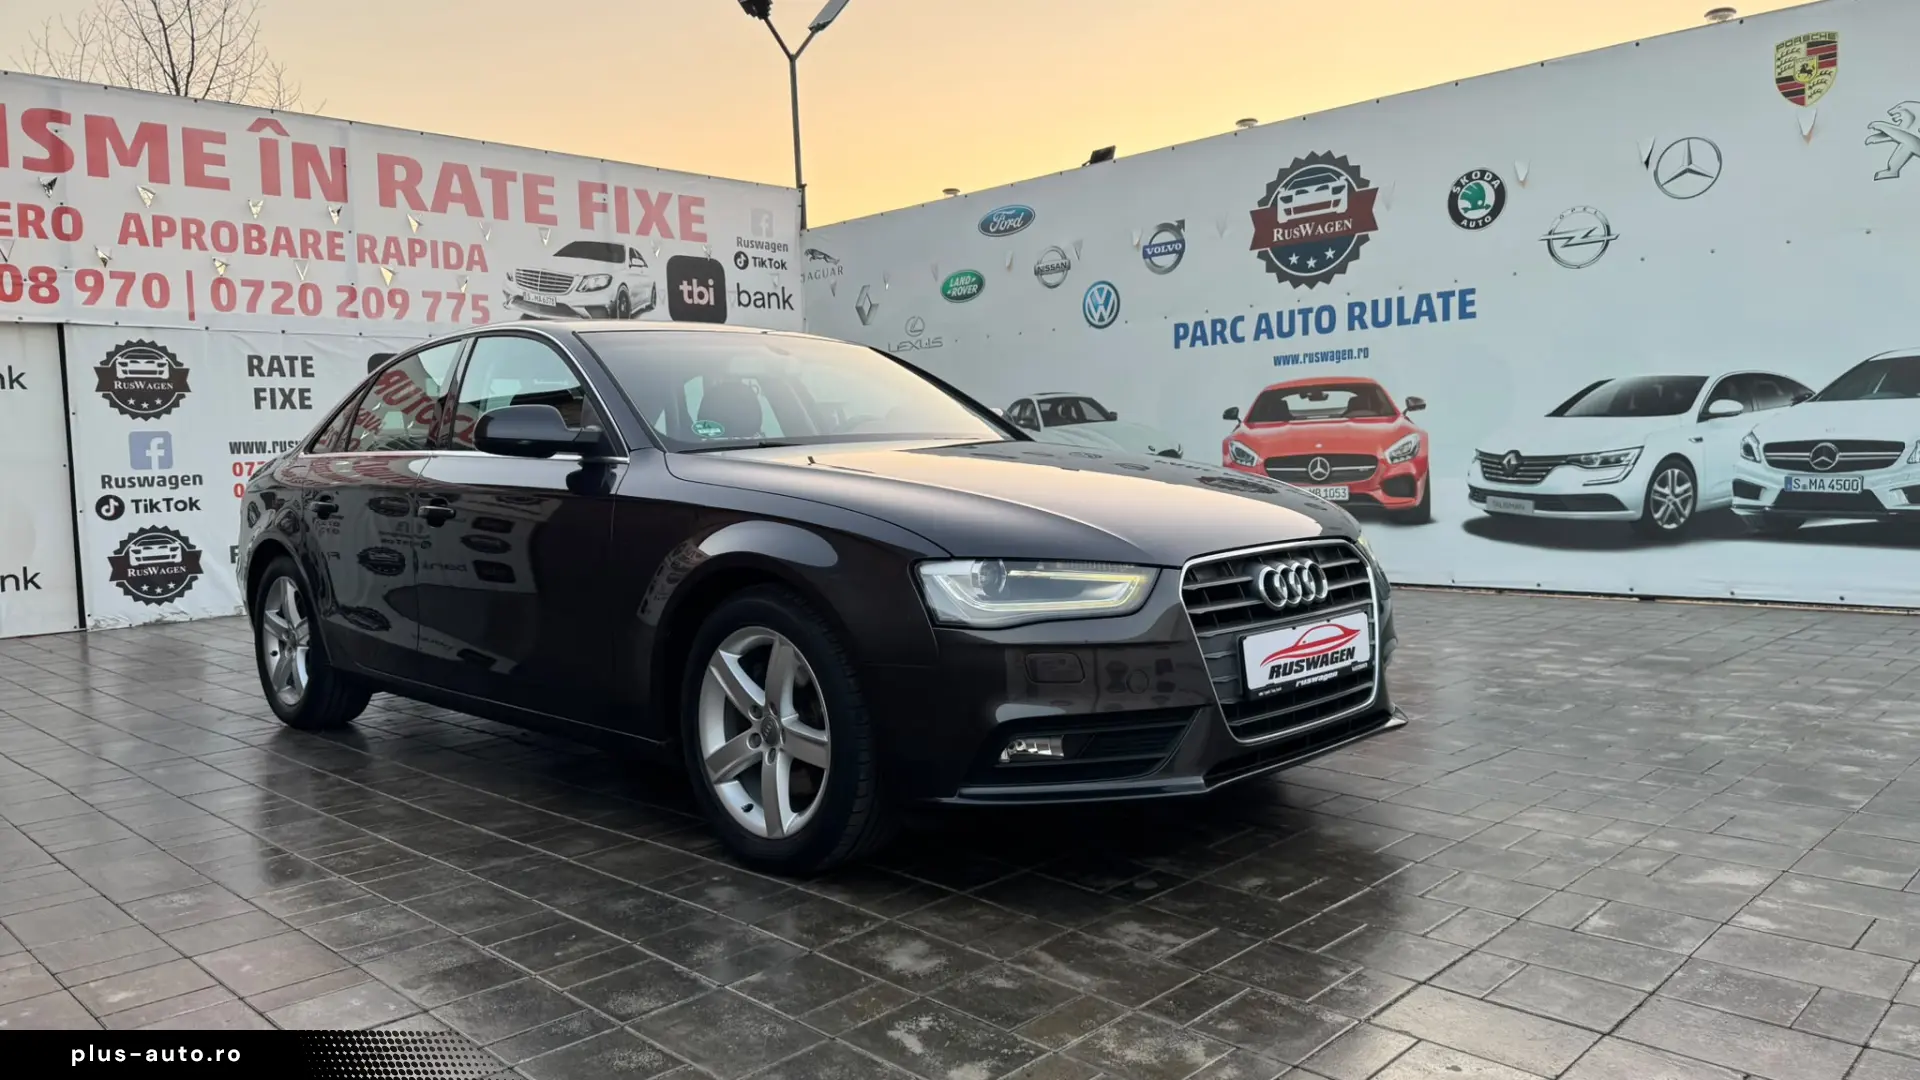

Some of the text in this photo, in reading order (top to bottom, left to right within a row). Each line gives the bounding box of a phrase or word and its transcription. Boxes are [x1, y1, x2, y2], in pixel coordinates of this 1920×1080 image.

[1776, 32, 1836, 52] PORSCHE
[247, 117, 348, 203] ÎN
[376, 152, 557, 227] RATE
[578, 180, 708, 243] FIXE
[989, 209, 1025, 232] Ford
[1460, 215, 1492, 228] AUTO
[117, 212, 345, 262] APROBARE
[356, 233, 489, 273] RAPIDA
[736, 236, 788, 253] Ruswagen
[1146, 242, 1182, 255] VOLVO
[751, 256, 788, 271] TikTok
[1037, 261, 1067, 273] NISSAN
[800, 265, 843, 283] JAGUAR
[949, 275, 971, 287] LAND
[75, 268, 171, 309] 970
[210, 276, 323, 316] 0720
[336, 285, 410, 321] 209
[422, 290, 490, 325] 775
[679, 278, 715, 306] tbi
[736, 282, 794, 311] bank
[951, 284, 978, 297] ROVER
[1173, 288, 1477, 349] PARC AUTO RULATE
[888, 337, 943, 352] LEXUS
[1273, 346, 1370, 367] www.ruswagen.ro
[247, 354, 315, 379] RATE
[253, 387, 313, 411] FIXE
[232, 461, 265, 477] 07
[101, 473, 203, 490] Ruswagen
[1793, 478, 1860, 492] S MA 4500
[1323, 487, 1347, 498] 1053
[130, 497, 202, 514] TikTok
[1268, 646, 1356, 680] RUSWAGEN
[1295, 670, 1339, 688] ruswagen
